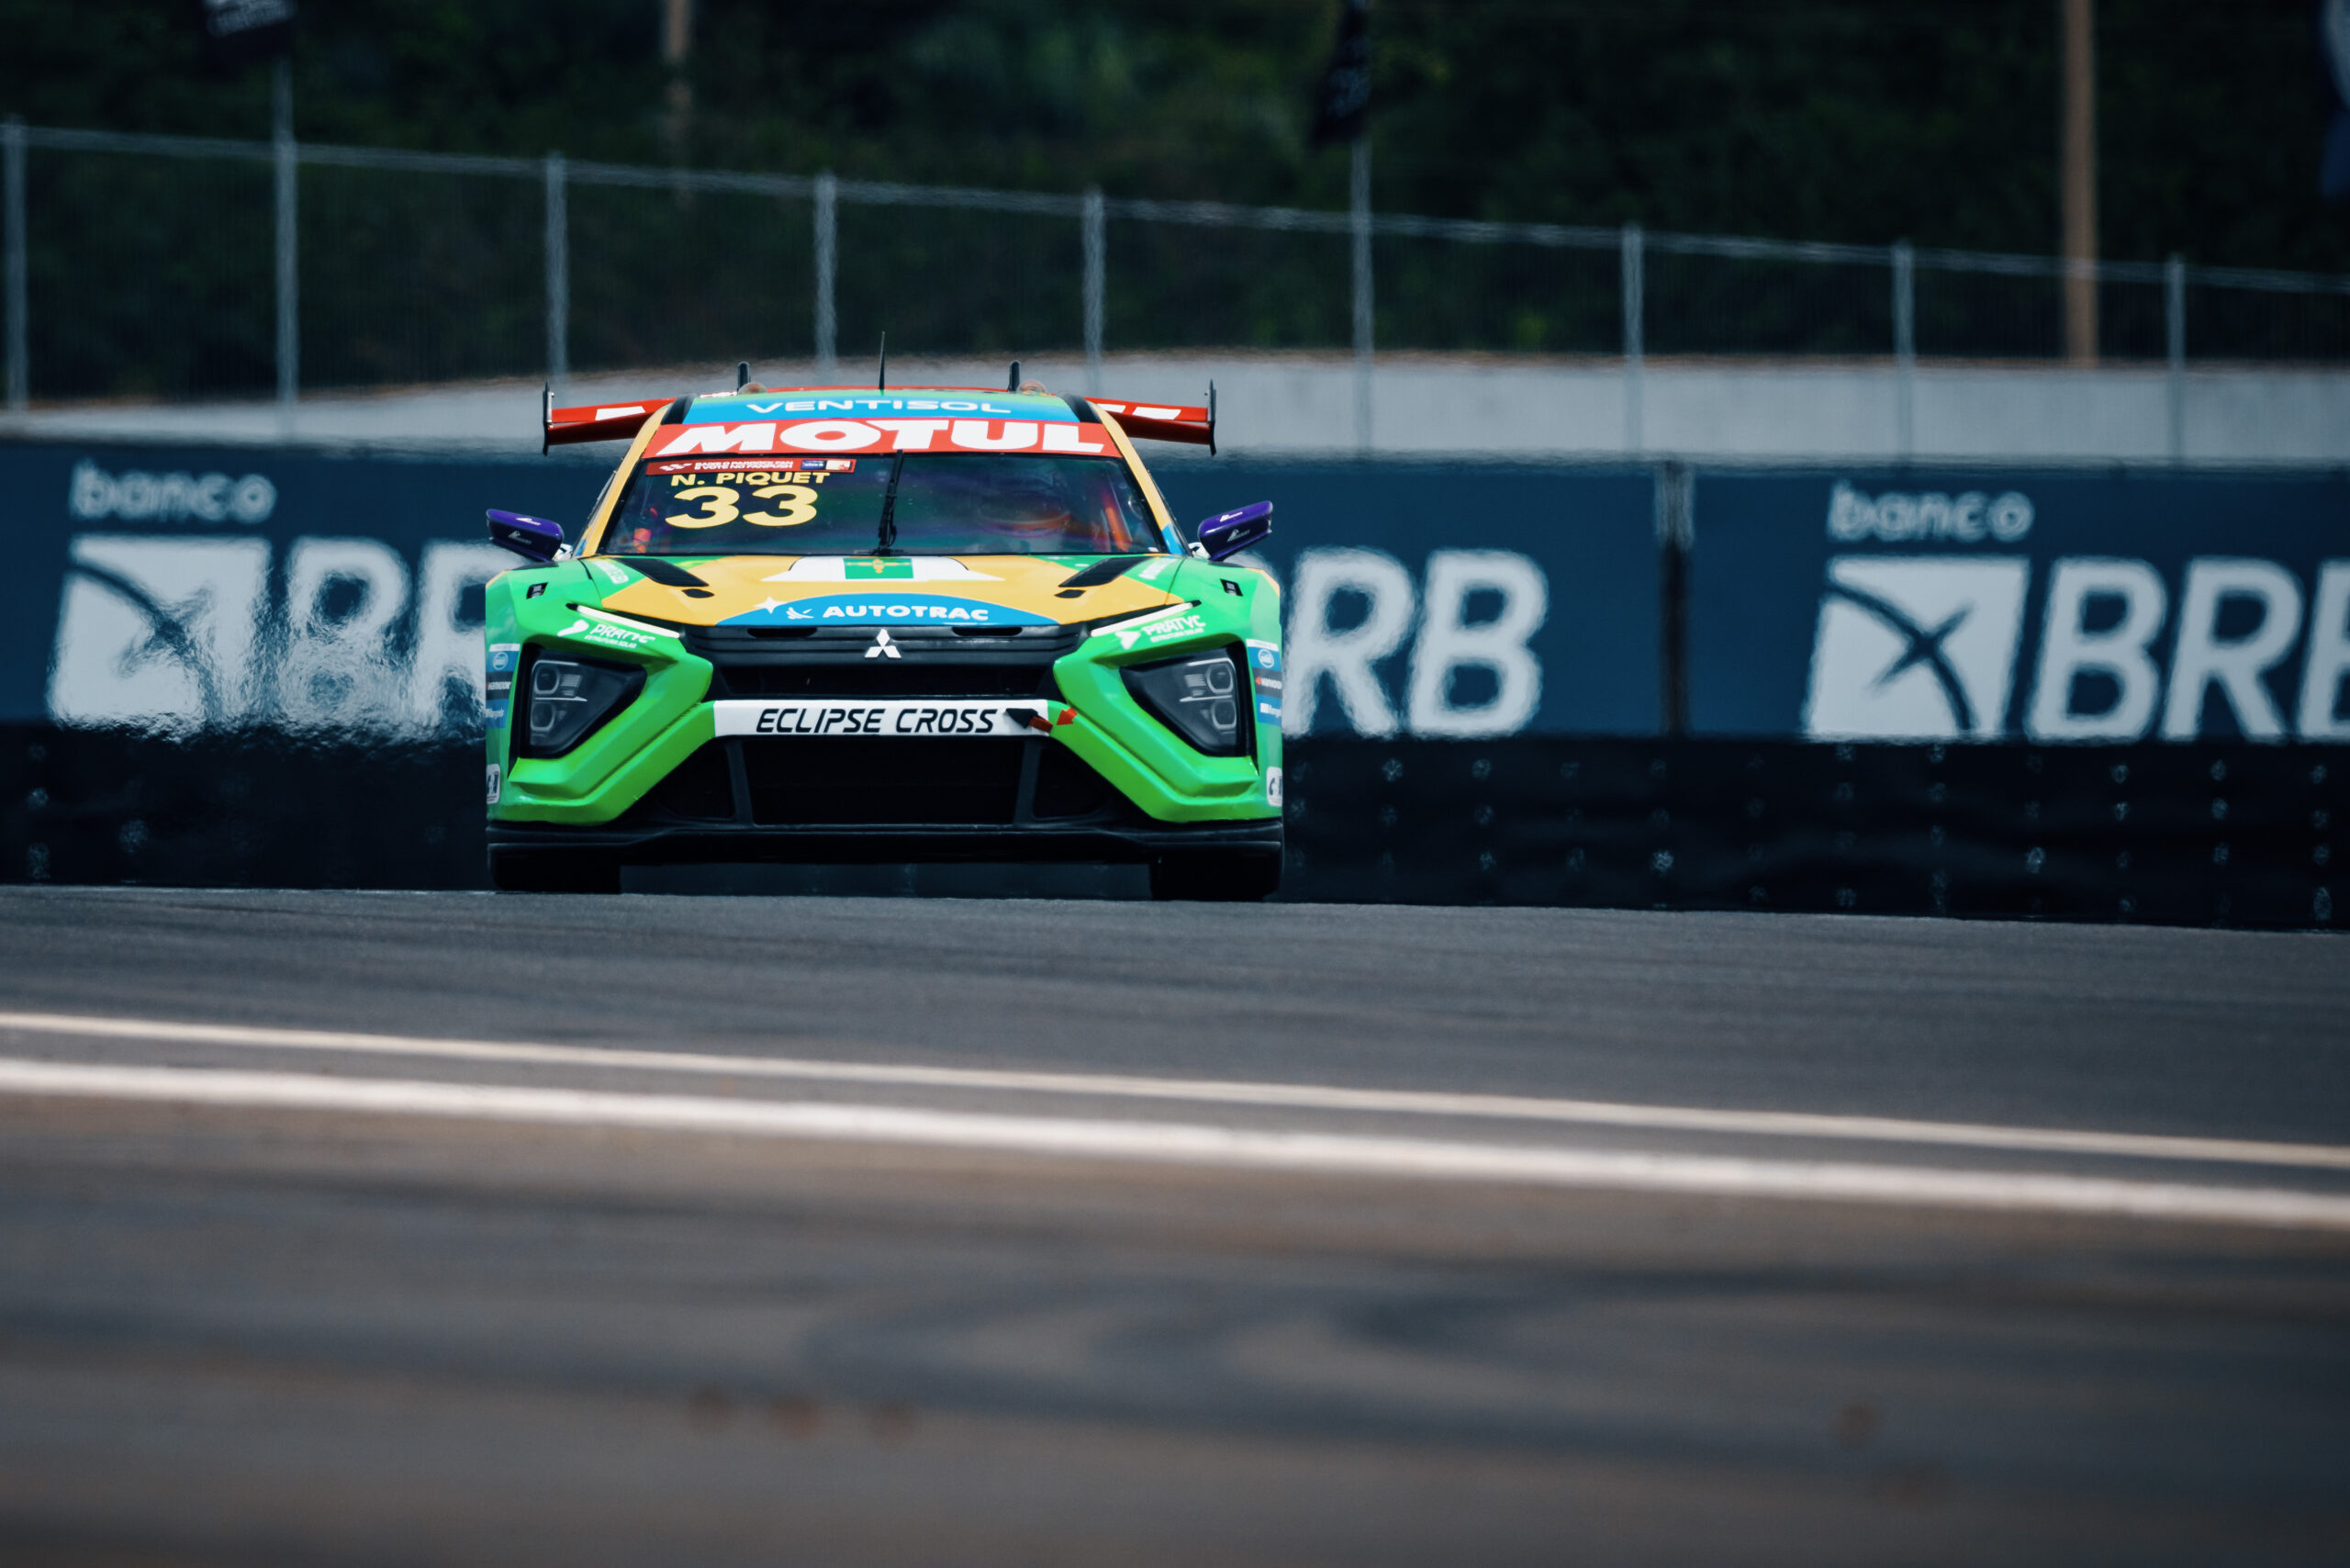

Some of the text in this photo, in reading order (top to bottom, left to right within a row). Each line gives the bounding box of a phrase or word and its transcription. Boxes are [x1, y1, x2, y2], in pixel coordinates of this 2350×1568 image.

[746, 399, 1012, 413] VENTISOL
[655, 420, 1104, 456] MOTUL
[71, 461, 276, 522] banco
[671, 472, 830, 487] N. PIQUET
[665, 485, 819, 529] 33
[1828, 481, 2034, 543] banco
[822, 605, 990, 621] AUTOTRAC
[279, 535, 528, 732] BR
[1225, 547, 1550, 737] RB
[755, 708, 999, 734] ECLIPSE CROSS
